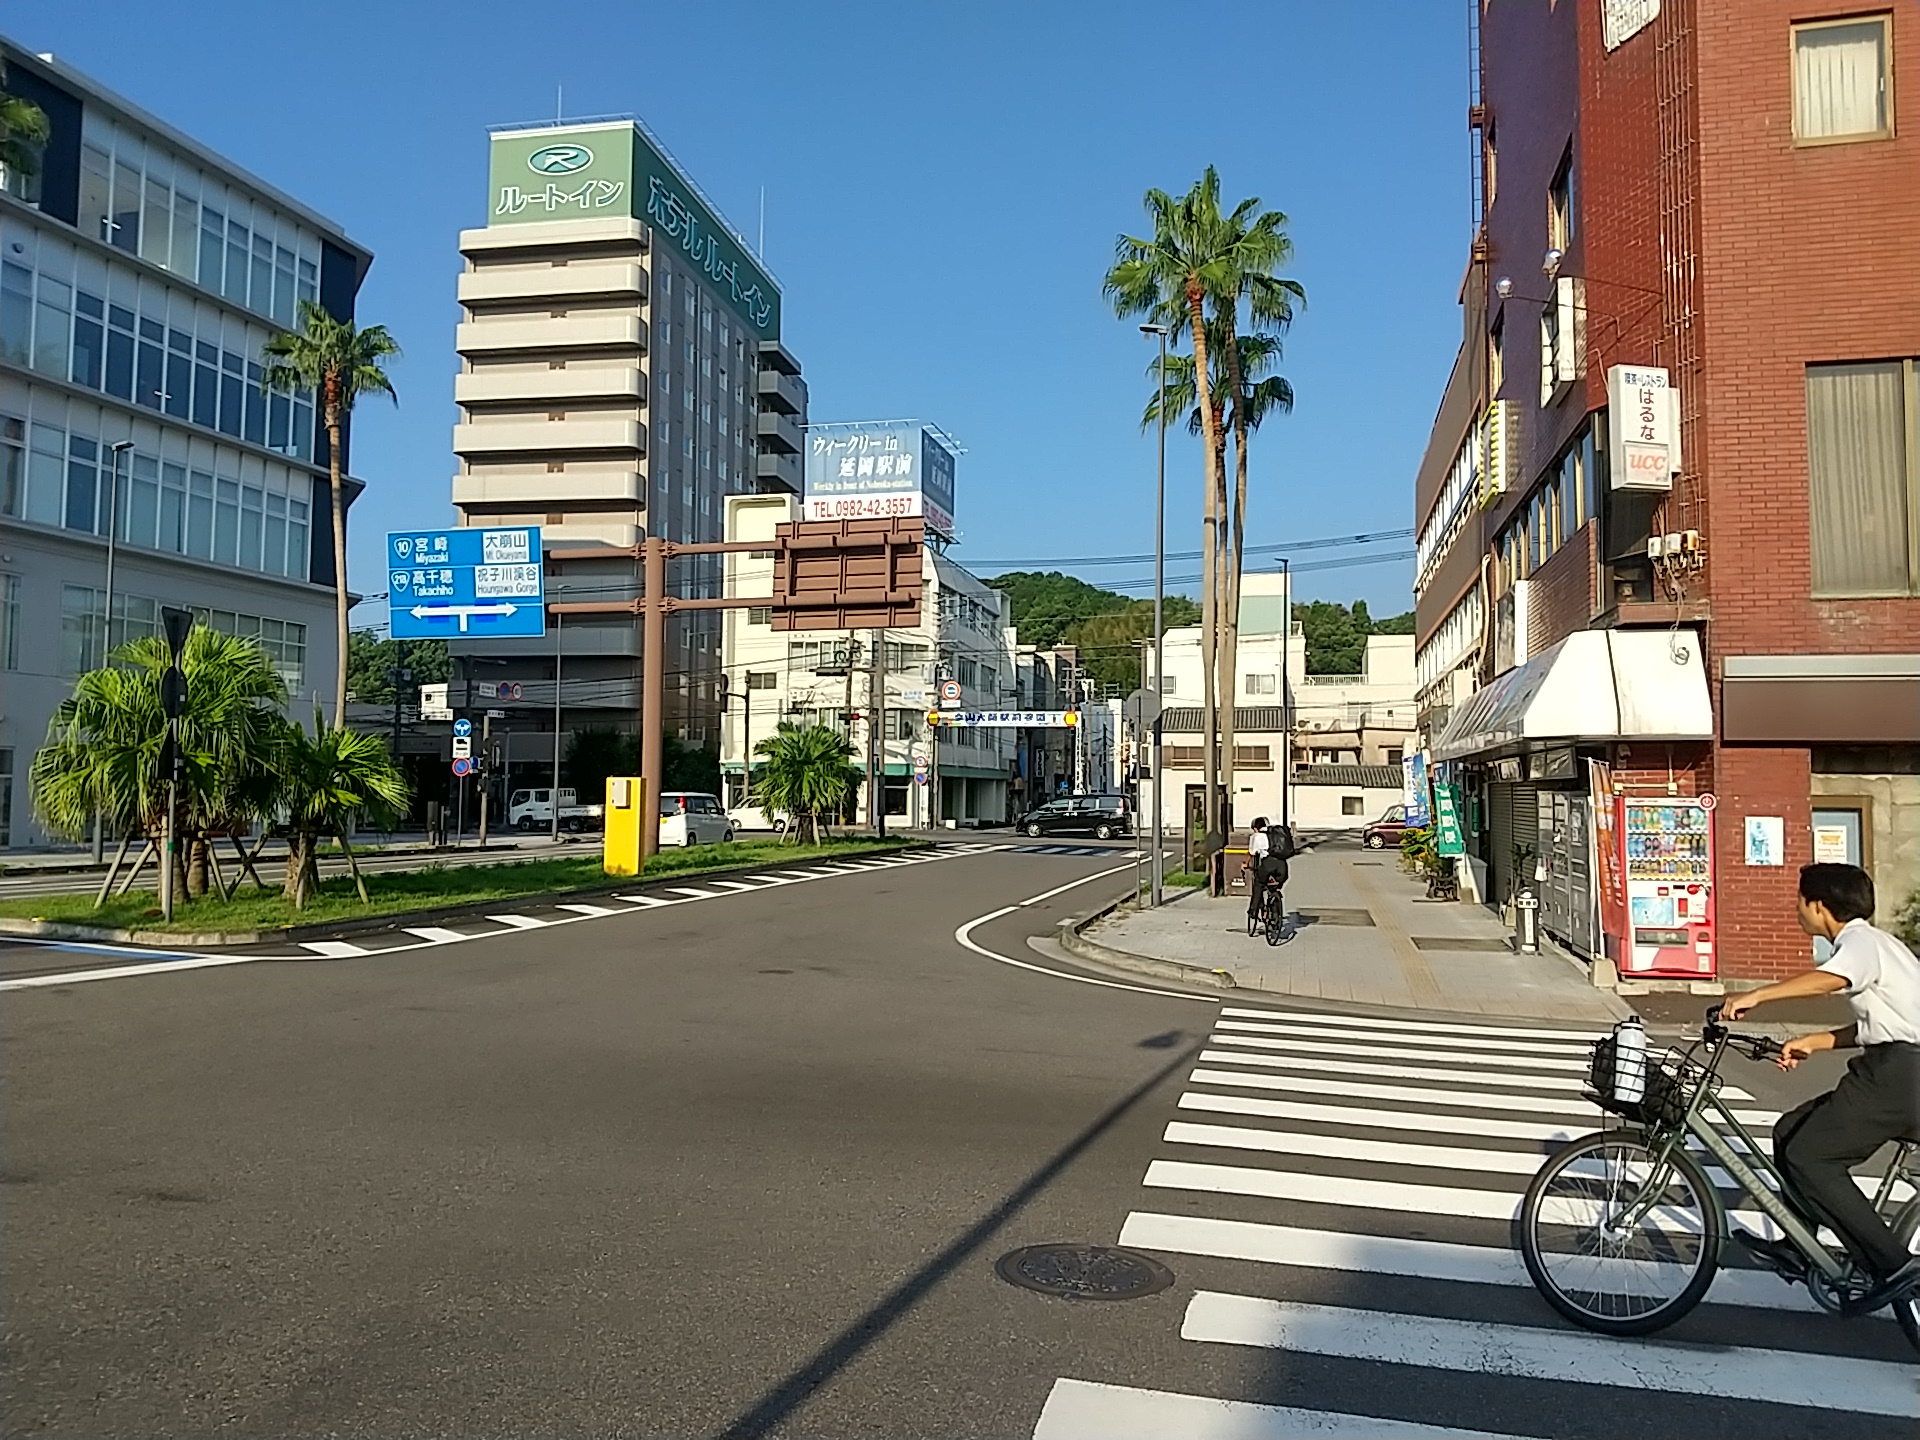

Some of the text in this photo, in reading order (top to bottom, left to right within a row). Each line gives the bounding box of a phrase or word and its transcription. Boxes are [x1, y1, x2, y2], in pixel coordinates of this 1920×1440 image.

[495, 180, 624, 215] ルートイン
[647, 174, 772, 329] ホテル ルートイン
[1639, 388, 1655, 441] はるな
[813, 434, 882, 457] ウィークリー
[838, 453, 913, 477] 延岡駅前
[397, 540, 409, 553] 10
[414, 536, 448, 552] 宮崎
[485, 534, 526, 549] 大崩山
[415, 551, 449, 565] Miyazaki
[412, 569, 454, 585] 高千穂
[477, 566, 537, 582] 祝子川渓谷
[412, 585, 454, 597] Takachiho
[515, 582, 538, 595] Gorge
